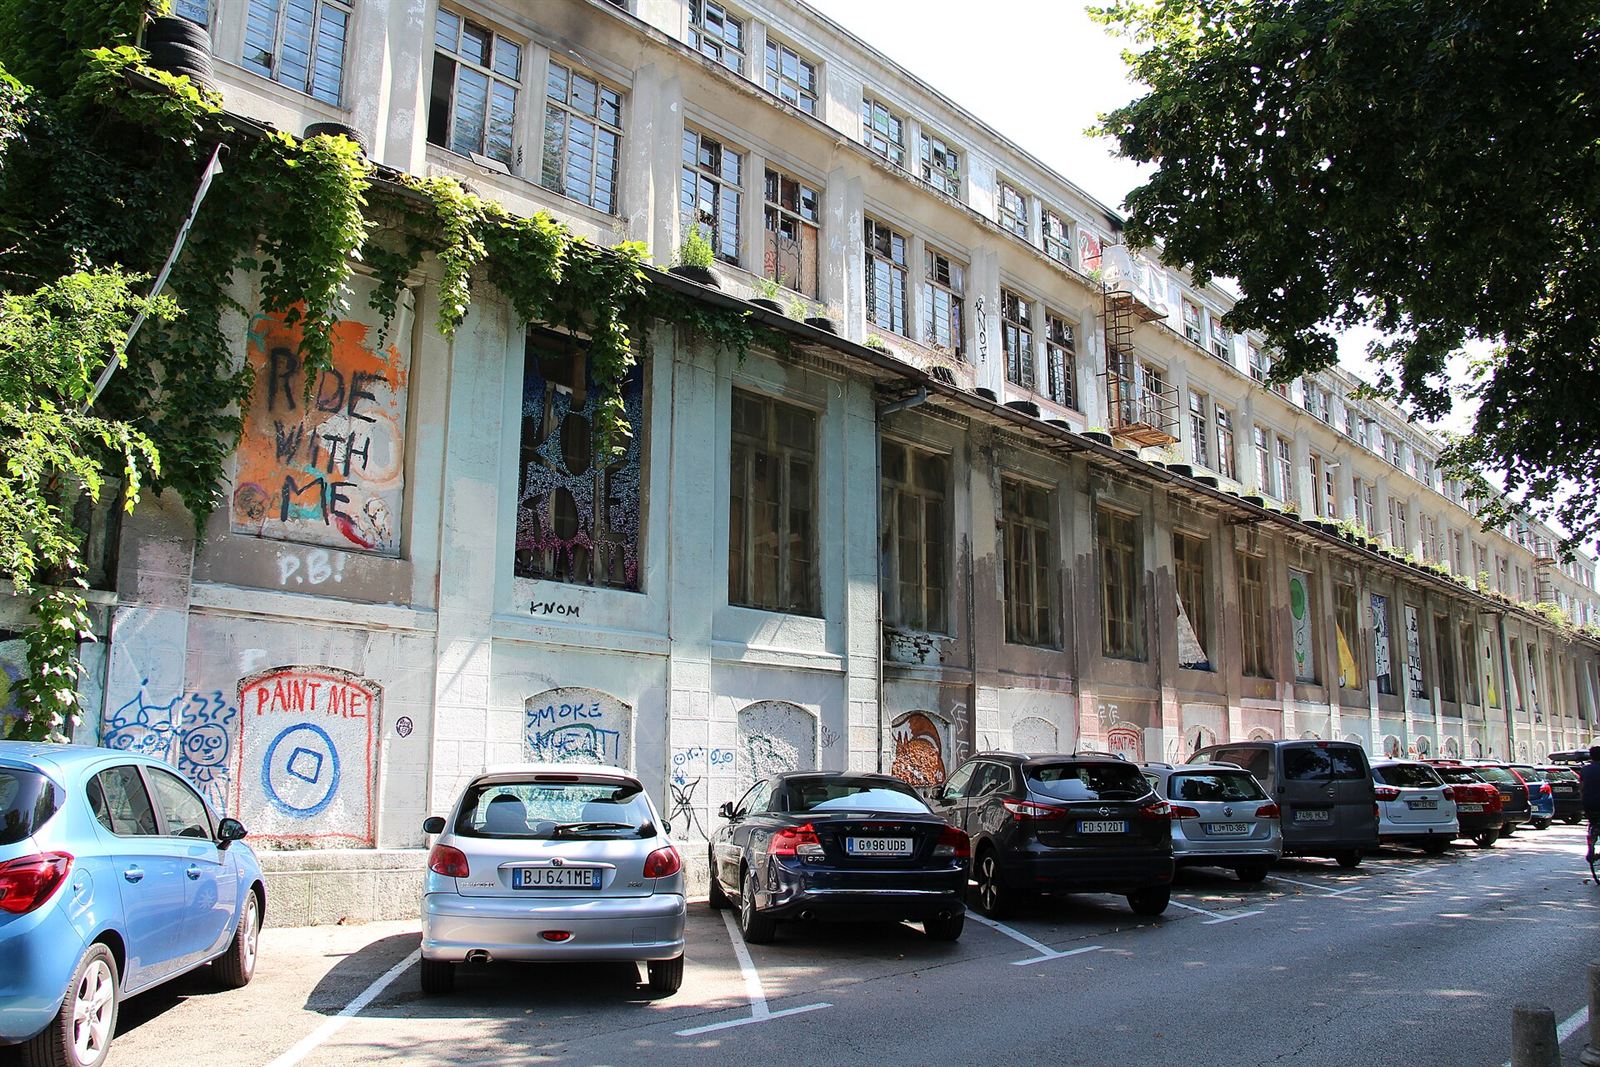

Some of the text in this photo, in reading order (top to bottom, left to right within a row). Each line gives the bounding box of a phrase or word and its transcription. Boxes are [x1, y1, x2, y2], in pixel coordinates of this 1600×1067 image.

[266, 347, 388, 423] RDE
[274, 418, 370, 477] WITH
[280, 475, 357, 525] ME
[530, 601, 580, 617] KNOM
[256, 678, 366, 719] PAINT ME
[527, 702, 602, 728] SMOKE
[858, 839, 906, 851] G 96 UDB
[523, 870, 542, 885] BJ
